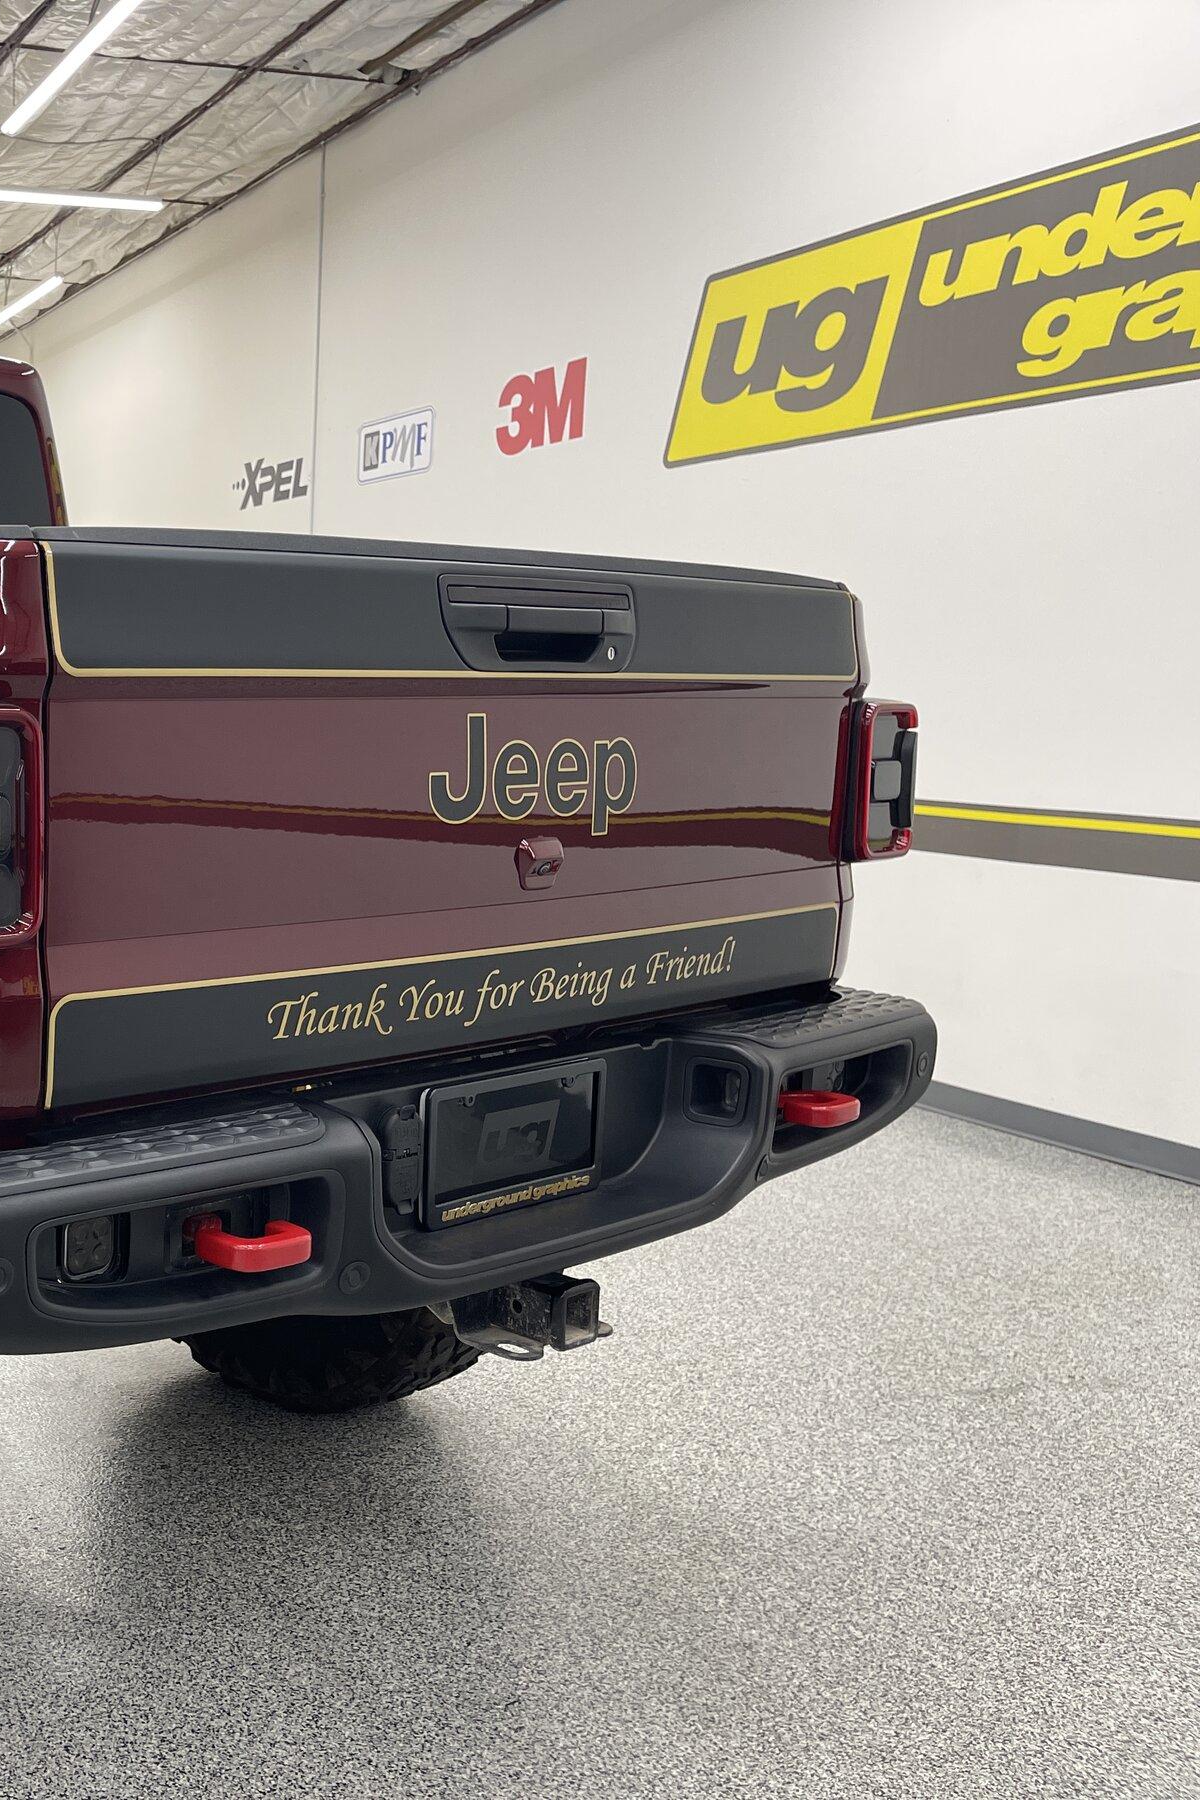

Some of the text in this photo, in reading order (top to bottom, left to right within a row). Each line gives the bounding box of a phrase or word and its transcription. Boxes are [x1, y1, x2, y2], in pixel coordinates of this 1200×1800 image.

[701, 275, 890, 412] ug
[1016, 269, 1200, 377] gra
[363, 422, 428, 471] KPMF
[496, 357, 587, 456] 3M
[239, 457, 308, 510] XPEL
[429, 713, 638, 836] Jeep
[267, 936, 737, 1040] Thank You for Being a Friend!
[441, 1175, 590, 1221] underground graphics
